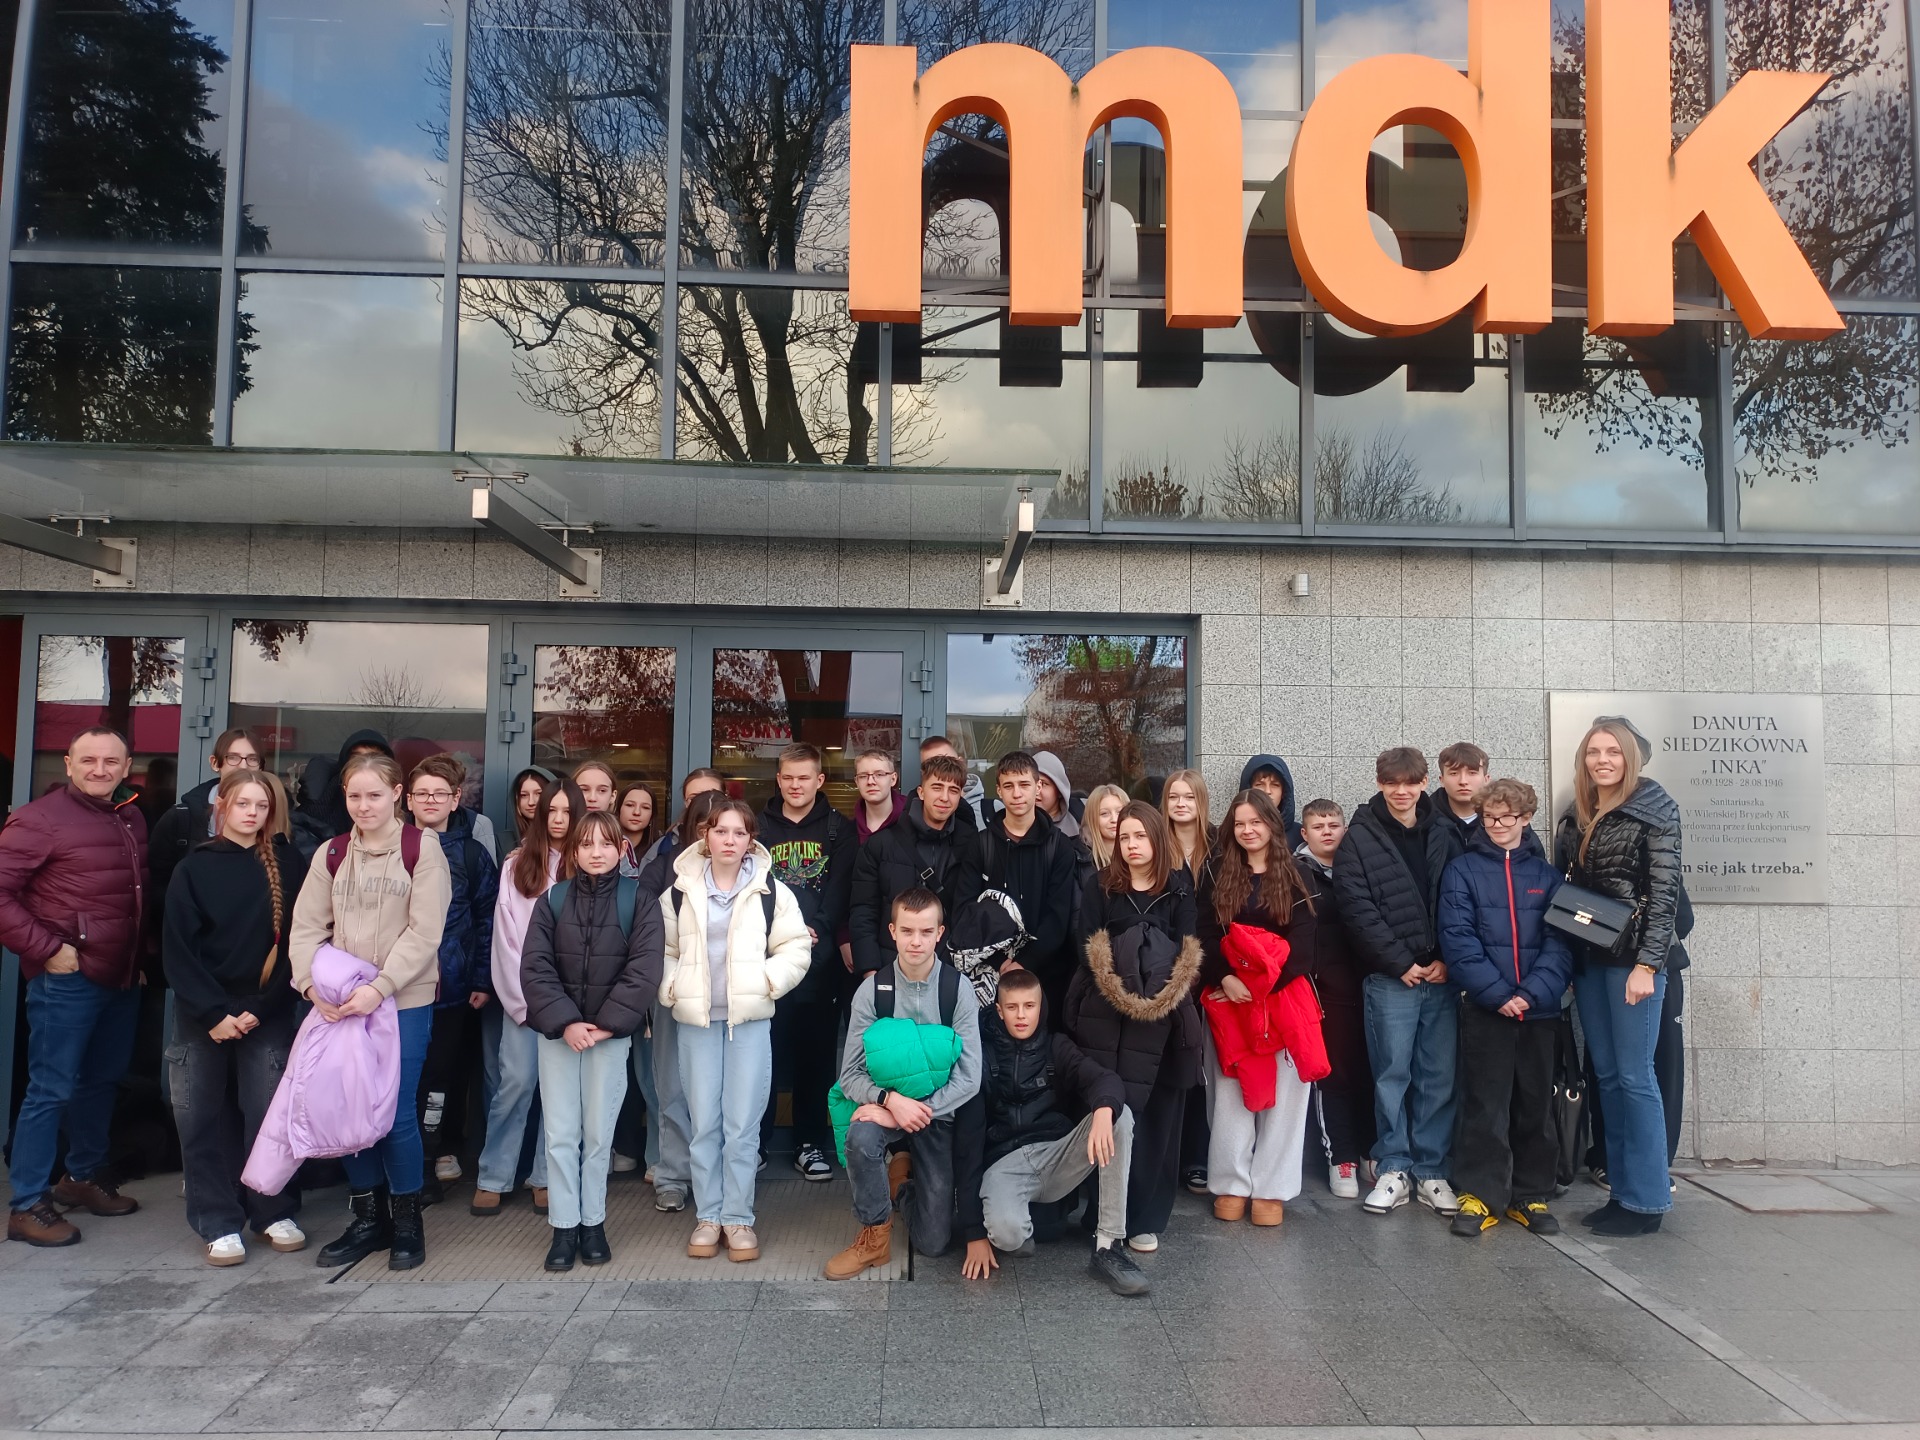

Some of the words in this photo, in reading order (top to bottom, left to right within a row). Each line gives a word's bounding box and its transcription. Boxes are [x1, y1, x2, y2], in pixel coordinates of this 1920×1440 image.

[850, 0, 1845, 341] mdk
[1692, 716, 1778, 731] DANUTA
[1662, 735, 1809, 753] SIEDZIKÓWNA
[1690, 778, 1734, 787] 03.09.1928
[1740, 778, 1783, 788] 28.08.1946
[1710, 797, 1765, 807] Sanitariuszka
[1740, 810, 1774, 820] Brygady
[1776, 810, 1790, 819] AK
[1681, 822, 1721, 831] ordowana
[1723, 823, 1745, 833] przez
[769, 841, 823, 864] GREMLINS
[1697, 861, 1718, 876] się
[1721, 861, 1747, 876] jak
